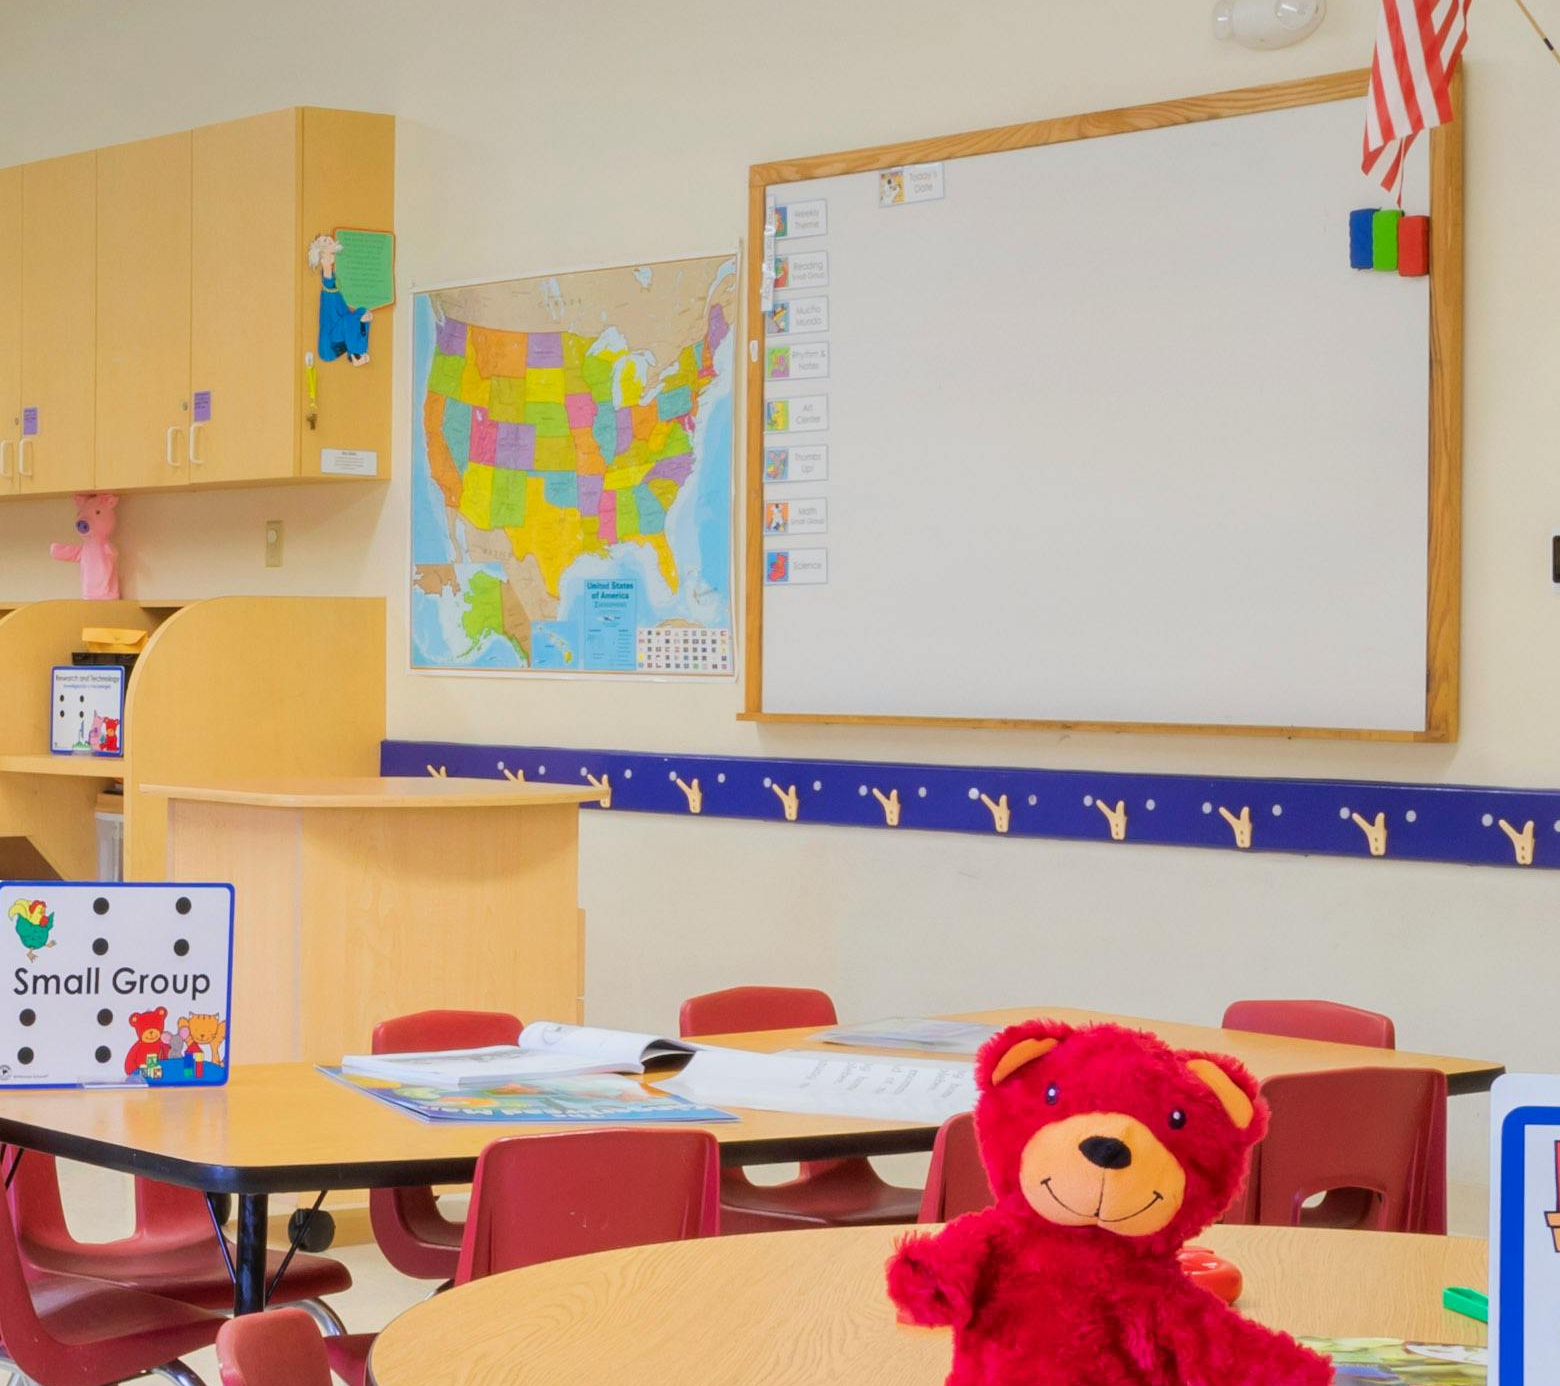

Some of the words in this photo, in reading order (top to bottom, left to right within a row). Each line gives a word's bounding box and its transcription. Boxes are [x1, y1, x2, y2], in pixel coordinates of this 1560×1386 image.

[587, 581, 610, 590] United
[611, 581, 634, 591] States
[591, 591, 599, 600] of
[600, 592, 630, 601] America
[13, 967, 100, 995] Small
[112, 967, 211, 1001] Group
